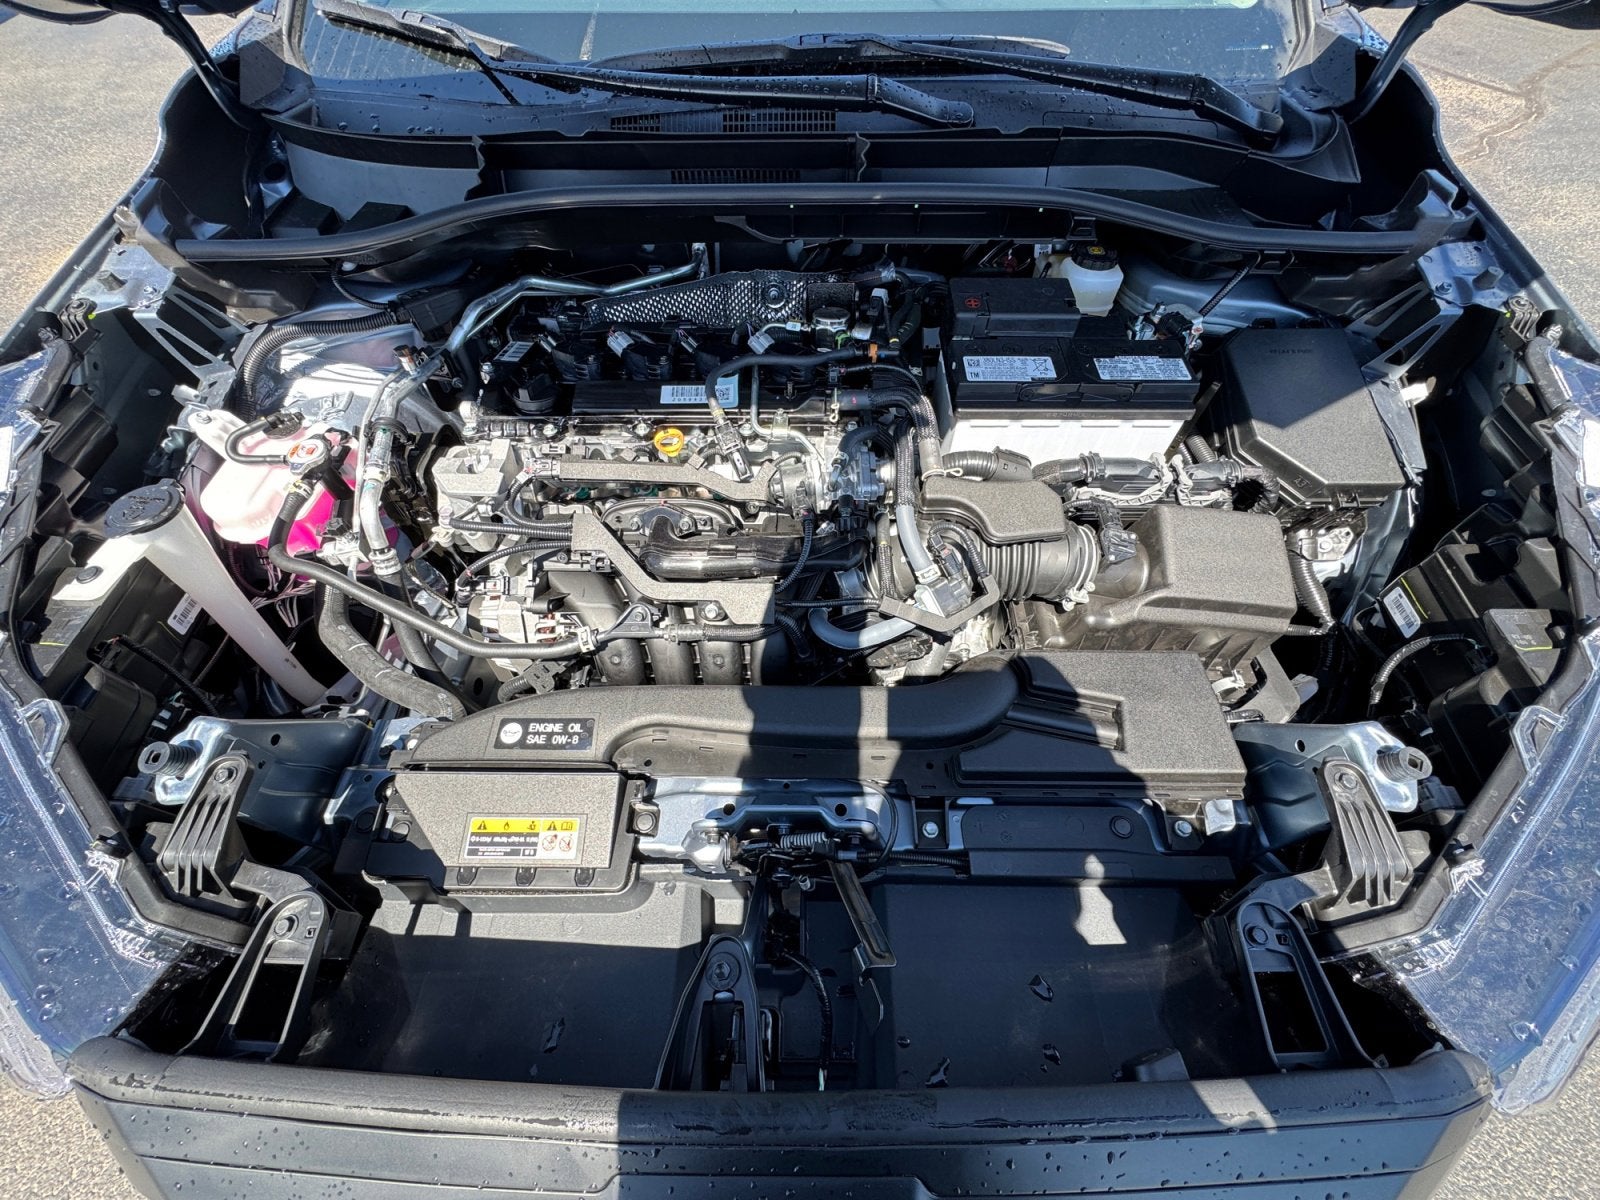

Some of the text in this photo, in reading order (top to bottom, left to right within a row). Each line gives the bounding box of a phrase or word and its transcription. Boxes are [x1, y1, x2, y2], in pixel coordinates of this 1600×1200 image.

[528, 723, 583, 732] ENGINE OIL
[526, 735, 579, 744] SAE 0W-8
